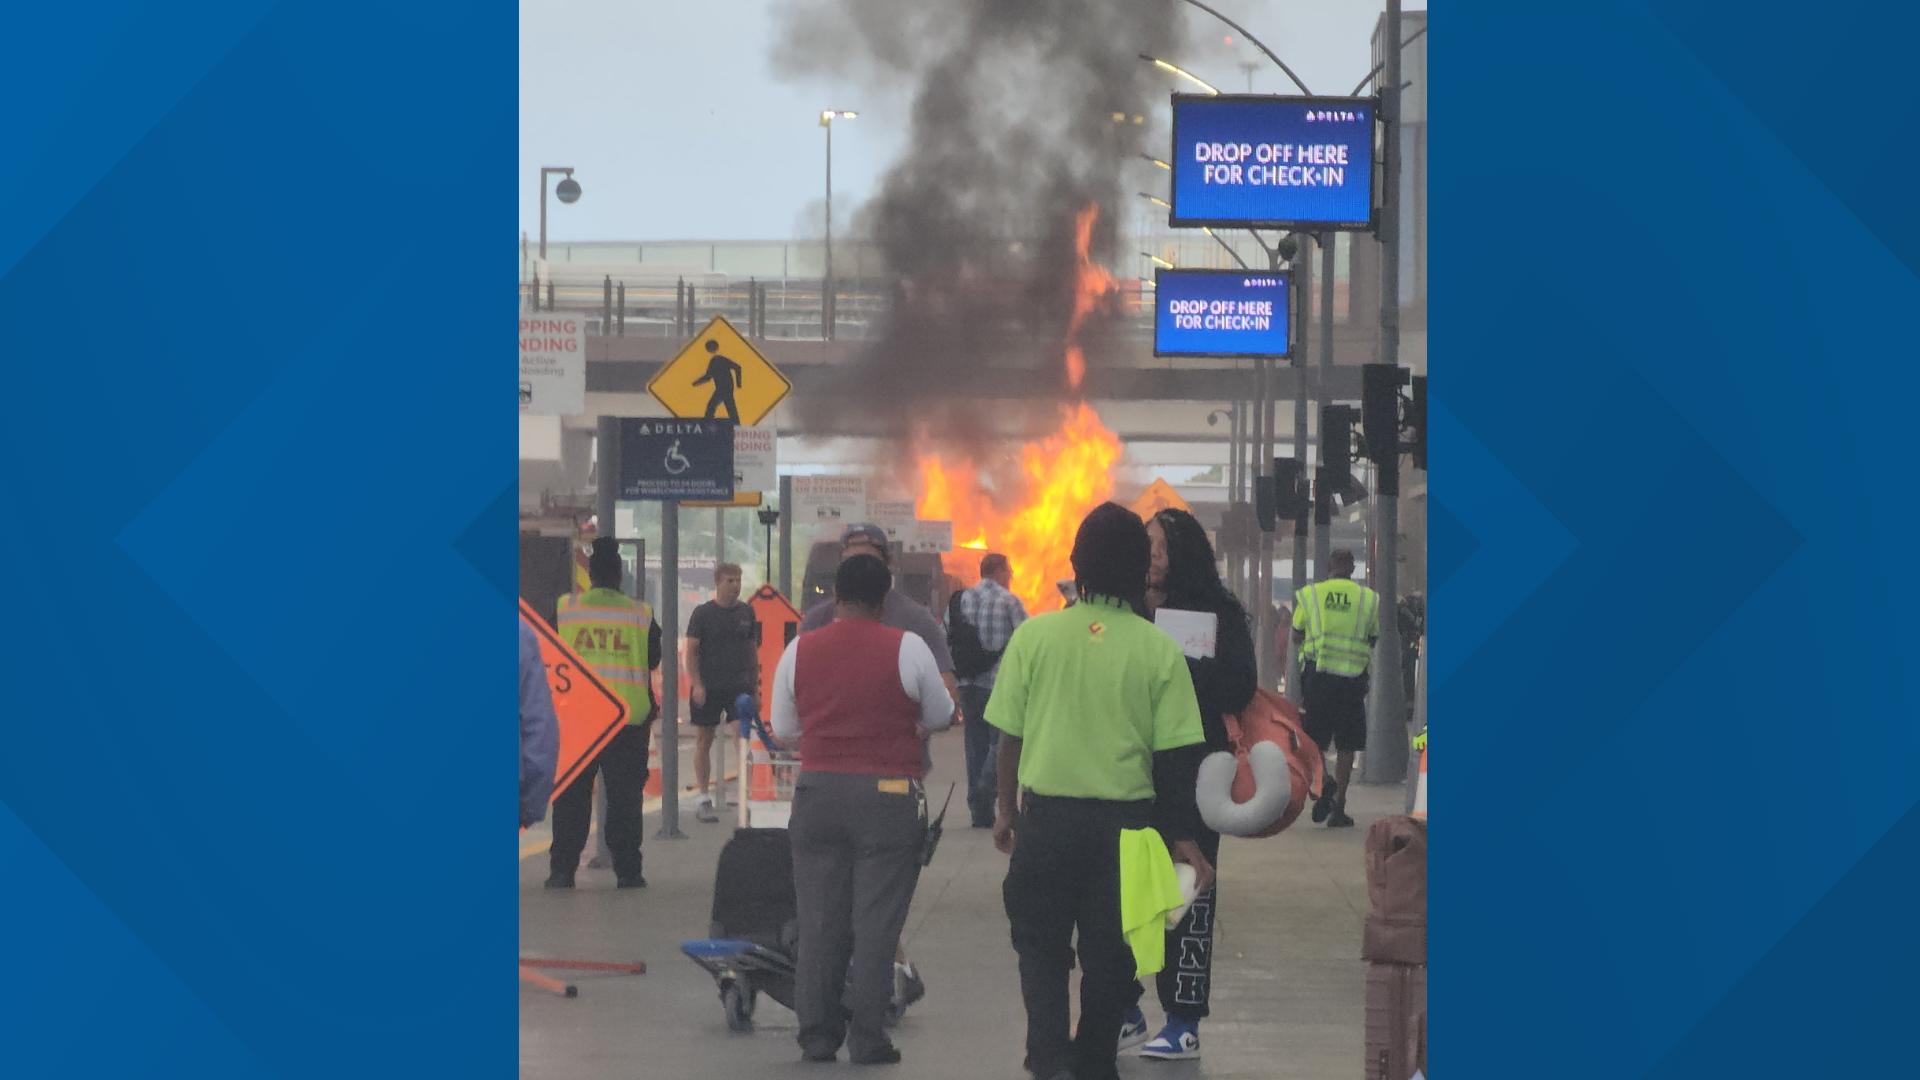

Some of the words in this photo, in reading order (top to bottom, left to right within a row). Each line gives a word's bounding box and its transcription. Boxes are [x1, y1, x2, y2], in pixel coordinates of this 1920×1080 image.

[1318, 111, 1355, 121] DELTA
[1195, 142, 1252, 163] DROP
[1256, 143, 1293, 164] OFF
[1299, 144, 1349, 165] HERE
[1205, 165, 1243, 185] FOR
[1170, 300, 1208, 314] DROP
[1210, 301, 1236, 315] OFF
[1238, 301, 1273, 315] HERE
[1176, 315, 1202, 329] FOR
[655, 423, 703, 435] DELTA
[1324, 592, 1351, 605] ATL
[574, 628, 631, 650] ATL
